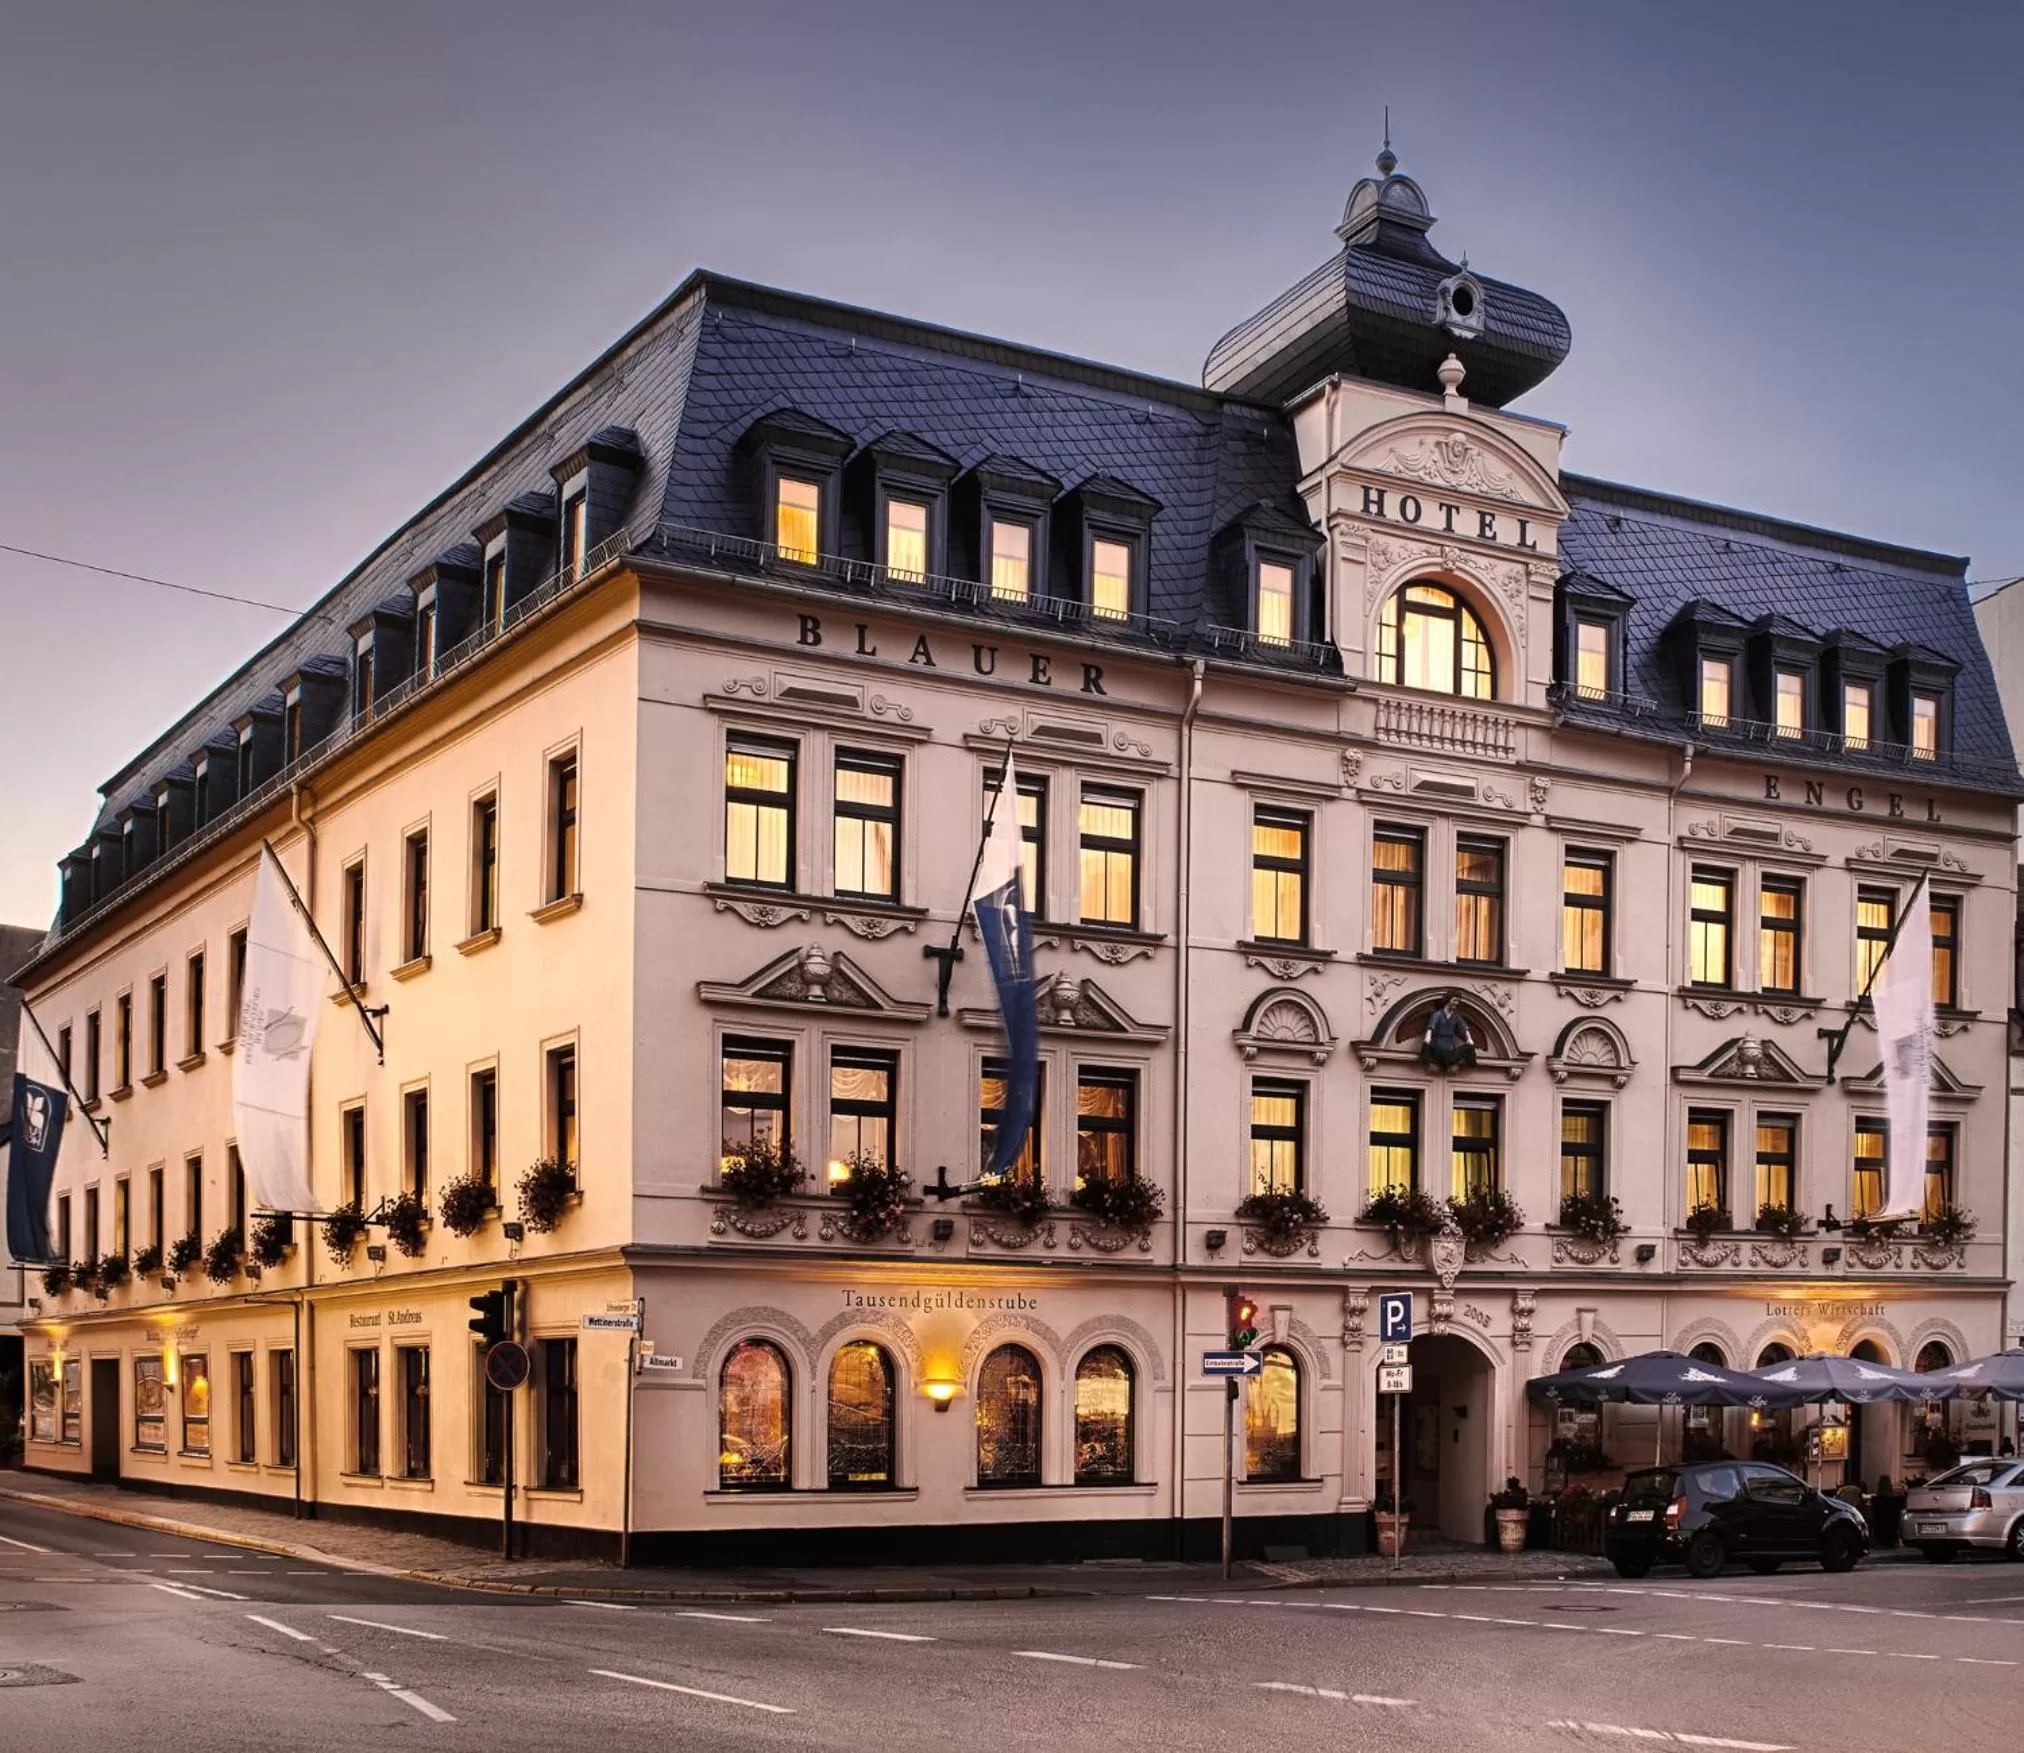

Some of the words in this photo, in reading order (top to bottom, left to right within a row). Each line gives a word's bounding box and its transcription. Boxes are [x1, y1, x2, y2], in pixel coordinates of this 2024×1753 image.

[1360, 485, 1537, 549] HOTEL
[796, 613, 1107, 695] BLAUER
[1764, 774, 1941, 822] ENGEL
[842, 1289, 1038, 1313] Tausendgüldenstube
[1817, 1301, 1886, 1316] Wirtschaft
[350, 1312, 381, 1328] Restaurant
[588, 1316, 634, 1328] Wettinerstraße
[1387, 1300, 1404, 1336] P
[649, 1357, 677, 1367] Altmarkt
